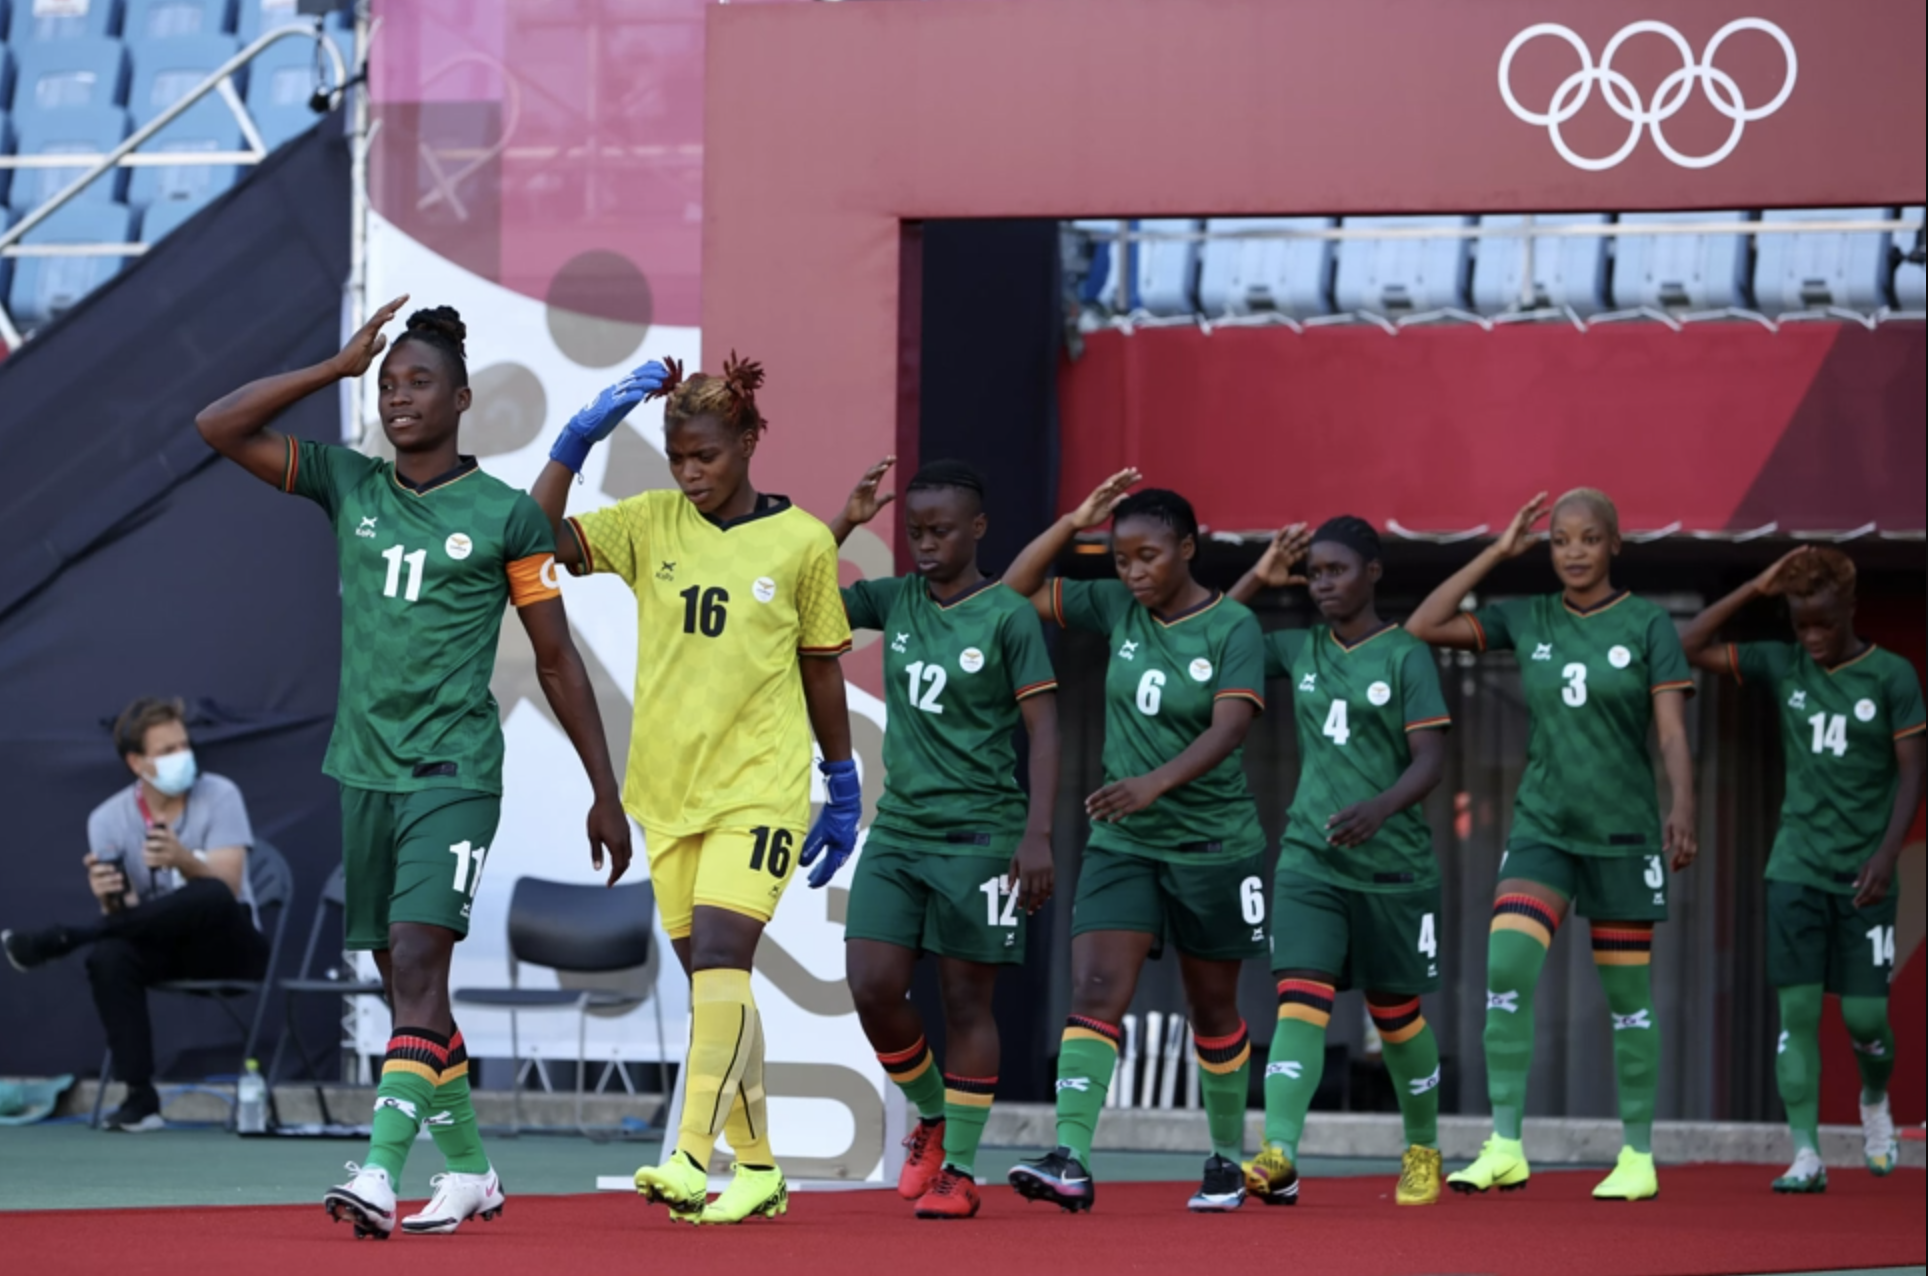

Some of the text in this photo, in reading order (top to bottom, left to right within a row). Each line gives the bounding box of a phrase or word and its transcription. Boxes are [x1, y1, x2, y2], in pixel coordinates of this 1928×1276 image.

[381, 544, 427, 602] 11
[679, 585, 730, 638] 16
[905, 660, 947, 715] 12
[1135, 668, 1167, 716] 6
[1561, 662, 1588, 708] 3
[1322, 698, 1351, 746] 4
[1808, 711, 1849, 758] 14
[450, 840, 486, 898] 11
[749, 825, 794, 880] 16
[1644, 854, 1665, 890] 3
[979, 873, 1020, 926] 12
[1240, 875, 1265, 925] 6
[1418, 912, 1437, 959] 4
[1865, 924, 1895, 967] 14
